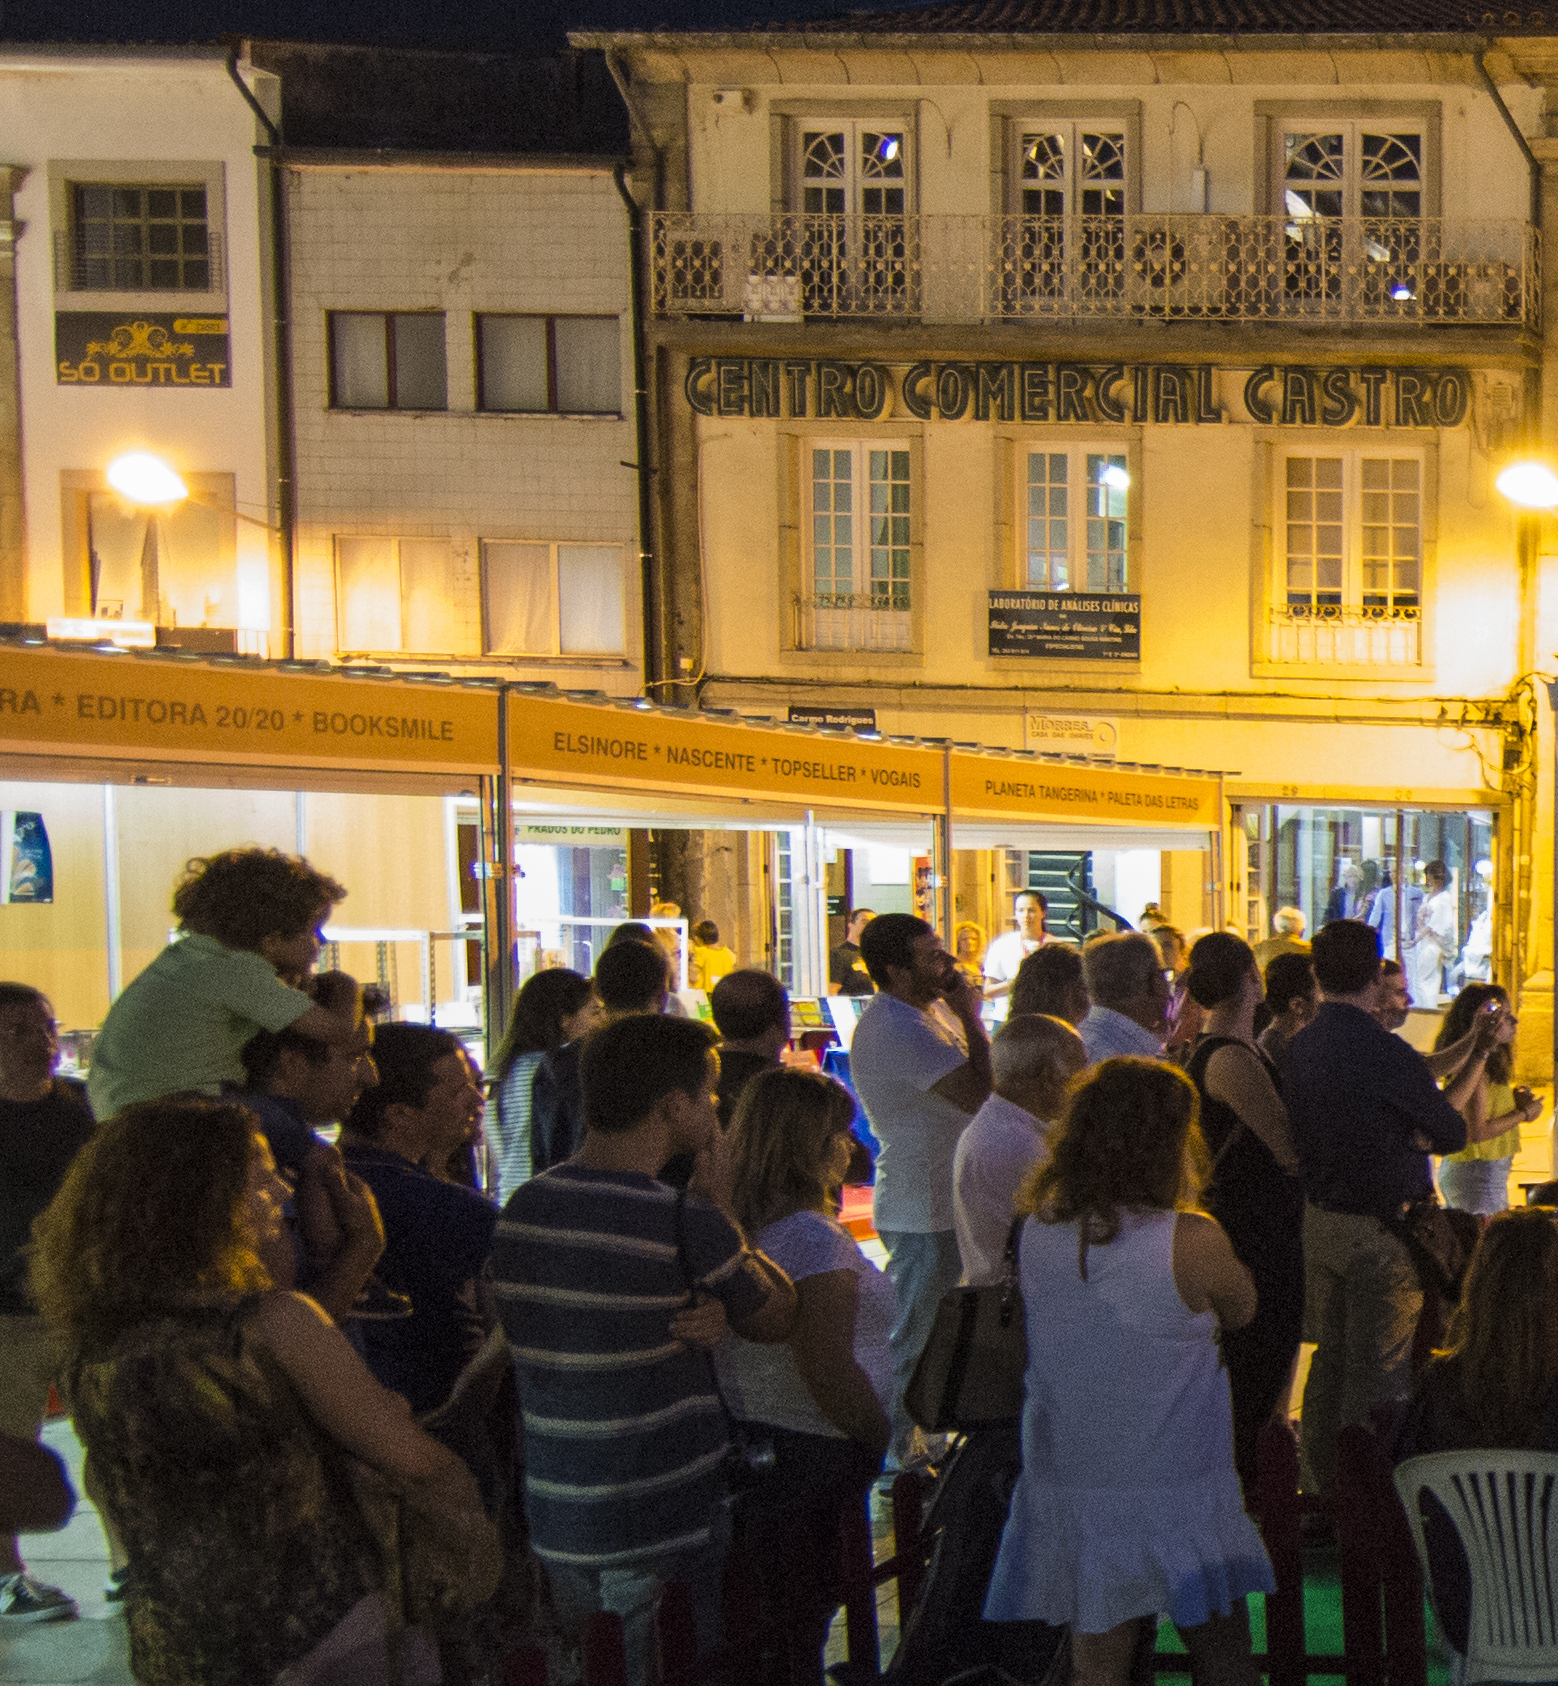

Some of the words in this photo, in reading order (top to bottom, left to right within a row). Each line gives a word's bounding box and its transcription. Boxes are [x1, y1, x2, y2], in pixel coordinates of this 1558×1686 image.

[109, 362, 226, 384] OUTLET
[685, 357, 887, 420] CENTRO
[902, 361, 1223, 423] COMERCIAL
[1244, 365, 1469, 428] CASTRO
[990, 595, 1046, 610] LABORATÓRIO
[1048, 599, 1059, 611] DE
[1061, 597, 1100, 612] ANÁLISES
[1102, 598, 1139, 613] CLÍNICAS
[77, 693, 208, 726] EDITORA
[216, 705, 285, 731] 20/20
[313, 710, 454, 742] BOOKSMILE
[825, 714, 874, 726] Rodrigues
[553, 731, 648, 760] ELSINORE
[667, 745, 756, 772] NASCENTE
[772, 758, 857, 783] TOPSELLER
[871, 768, 921, 789] VOGAIS
[985, 780, 1036, 799] PLANETA
[1039, 785, 1099, 804] TANGERINA
[1108, 791, 1143, 807] PALETA
[1145, 794, 1164, 809] DAS
[1166, 796, 1200, 811] LETRAS
[570, 825, 585, 835] DO
[588, 826, 621, 836] PEDRO
